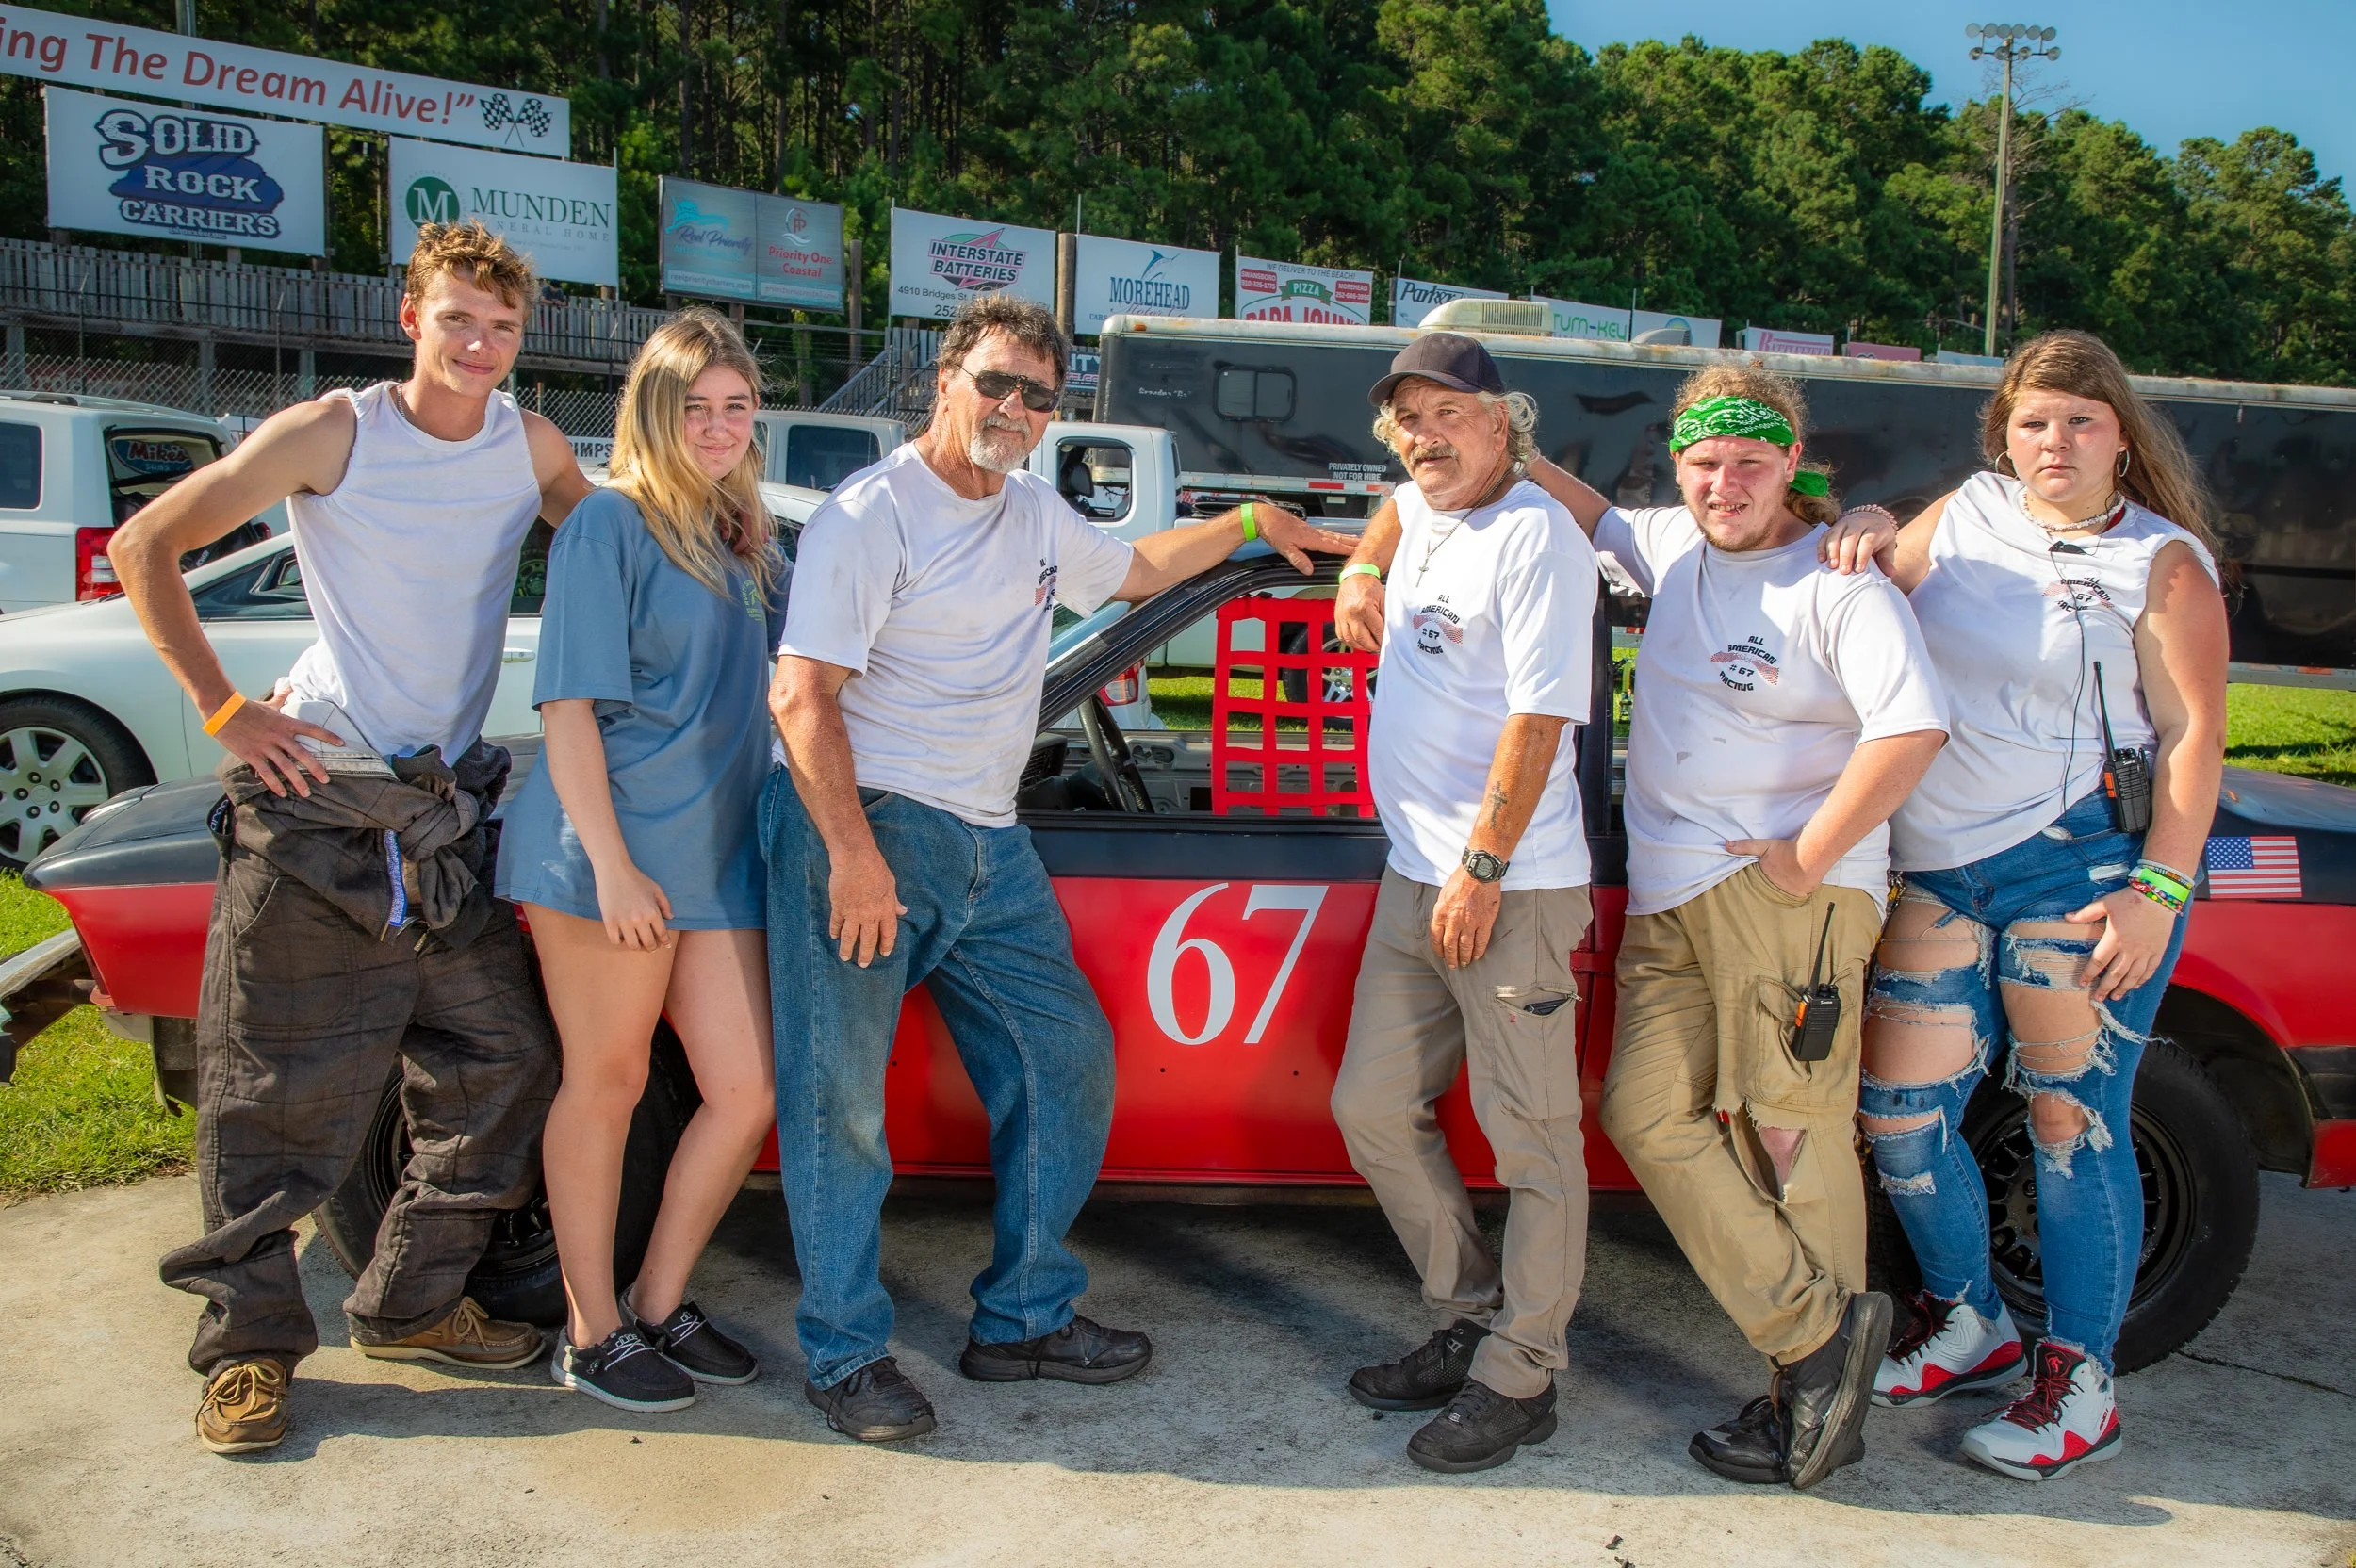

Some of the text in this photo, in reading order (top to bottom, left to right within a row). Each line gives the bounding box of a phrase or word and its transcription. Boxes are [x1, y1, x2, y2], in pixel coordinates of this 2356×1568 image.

[86, 33, 168, 80] The
[183, 50, 327, 106] Dream
[97, 110, 254, 167] SOLID
[143, 164, 262, 203] ROCK
[413, 187, 452, 224] M
[470, 188, 612, 229] MUNDEN
[122, 199, 279, 237] CARRIERS
[564, 228, 611, 243] HOME
[768, 245, 834, 265] Priority One
[930, 242, 1023, 266] INTERSTATE
[782, 262, 823, 278] Coastal
[933, 259, 1017, 282] BATTERIES
[1241, 270, 1276, 282] SWANSBORO
[1267, 263, 1277, 271] WE
[1277, 265, 1306, 275] DELIVER
[1317, 269, 1331, 278] THE
[1331, 270, 1356, 280] BEACH!
[897, 286, 921, 296] 4910
[922, 288, 956, 301] Bridges
[1109, 277, 1190, 310] MOREHEAD
[1292, 283, 1319, 297] PIZZA
[1337, 283, 1368, 291] MOREHEAD
[1400, 281, 1456, 305] Parker
[1328, 462, 1387, 473] PRIVATELY OWNED
[1333, 471, 1382, 482] NOT FOR HIRE
[1437, 594, 1450, 604] ALL
[2075, 593, 2093, 603] 67
[1419, 604, 1461, 625] AMERICAN
[1428, 629, 1440, 640] 67
[1747, 635, 1764, 646] ALL
[1727, 644, 1777, 665] AMERICAN
[1719, 670, 1755, 692] RACING
[1738, 667, 1755, 678] 67
[1147, 882, 1330, 1046] 67
